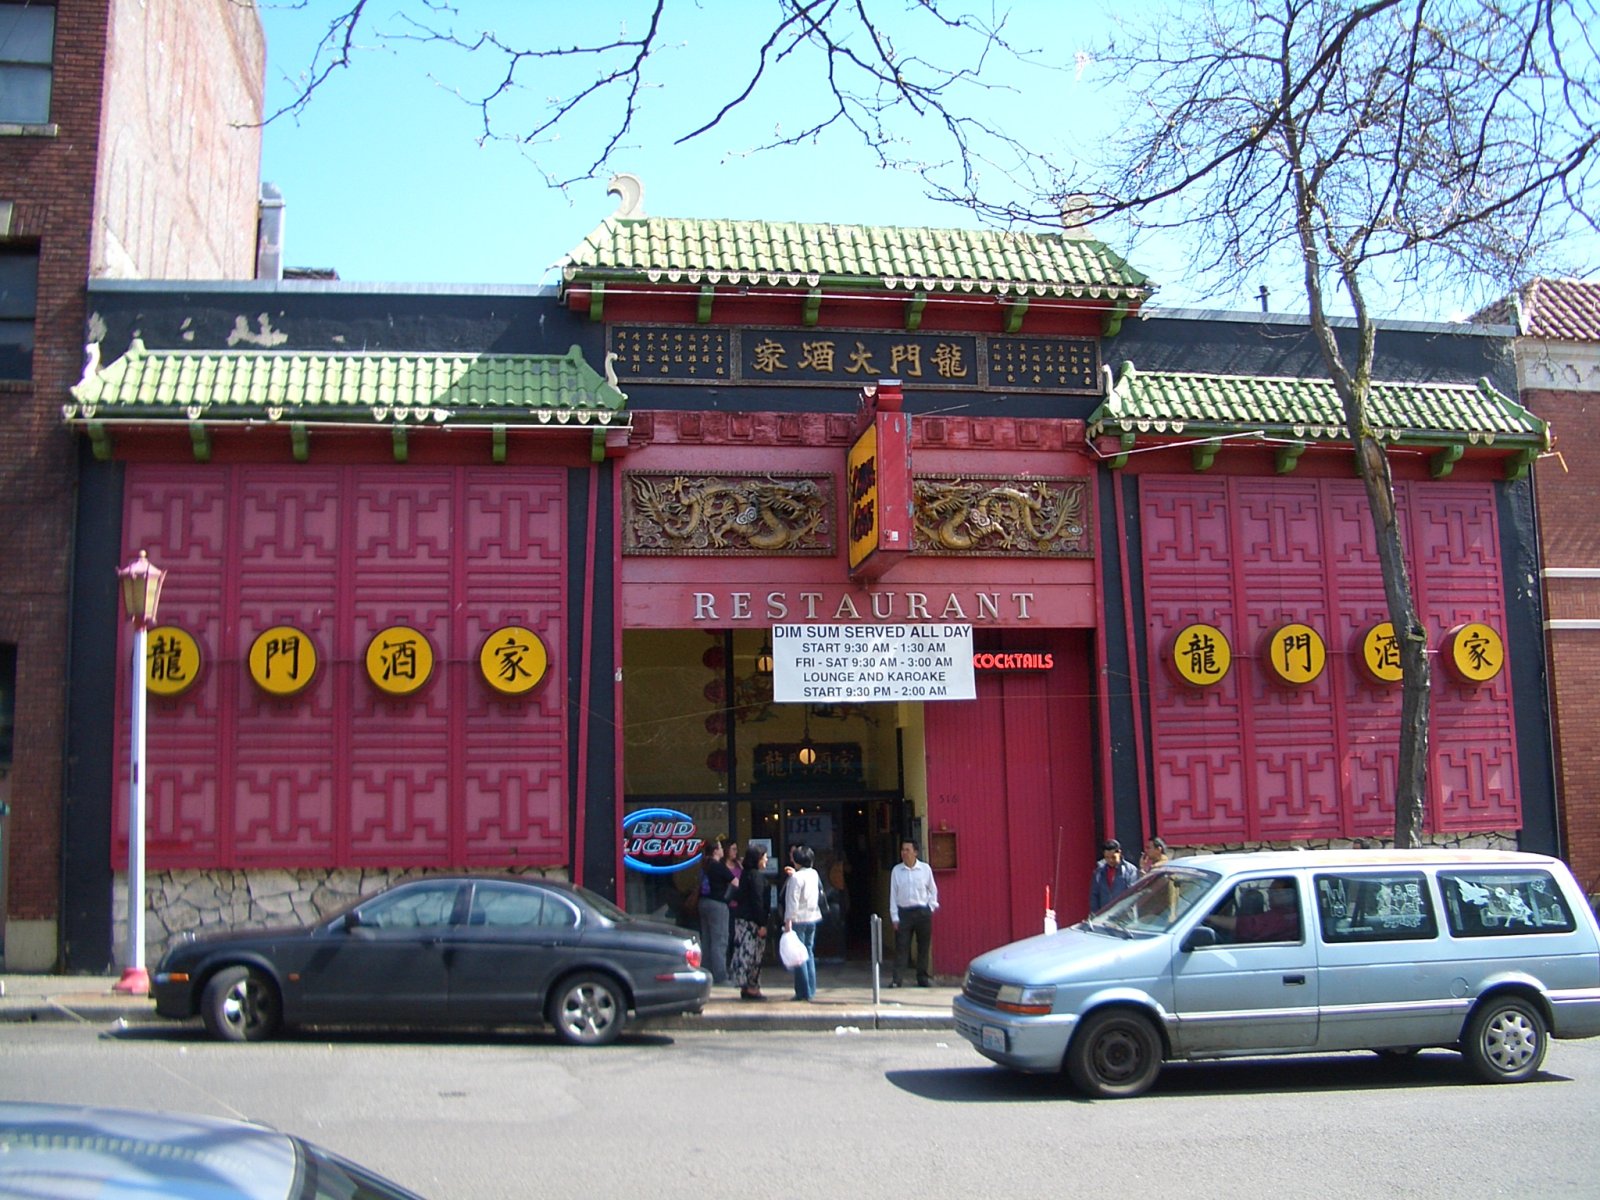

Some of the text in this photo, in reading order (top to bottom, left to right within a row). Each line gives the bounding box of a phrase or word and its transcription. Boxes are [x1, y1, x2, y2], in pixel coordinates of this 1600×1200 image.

[693, 592, 1035, 620] RESTAURANT
[774, 626, 971, 638] DIM SUM SERVED ALL DAY
[802, 643, 841, 653] START
[844, 643, 869, 653] 9:30
[872, 643, 890, 653] AM
[900, 643, 924, 653] 1:30
[927, 643, 946, 653] AM
[1182, 633, 1221, 676] 龍
[1283, 633, 1312, 673] 門
[1463, 632, 1494, 671] 家
[146, 636, 532, 682] 龍 門 酒 家
[795, 657, 815, 668] FRI
[825, 657, 849, 668] SAT
[852, 657, 876, 668] 9:30
[879, 657, 897, 668] AM
[907, 657, 932, 668] 3:00
[935, 657, 953, 668] AM
[973, 653, 1054, 669] COCKTAILS
[803, 672, 946, 682] LOUNGE AND KAROAKE
[803, 686, 842, 697] START
[845, 686, 870, 697] 9:30
[873, 686, 891, 697] PM
[901, 686, 926, 697] 2:00
[929, 686, 947, 697] AM
[632, 821, 697, 838] BUD
